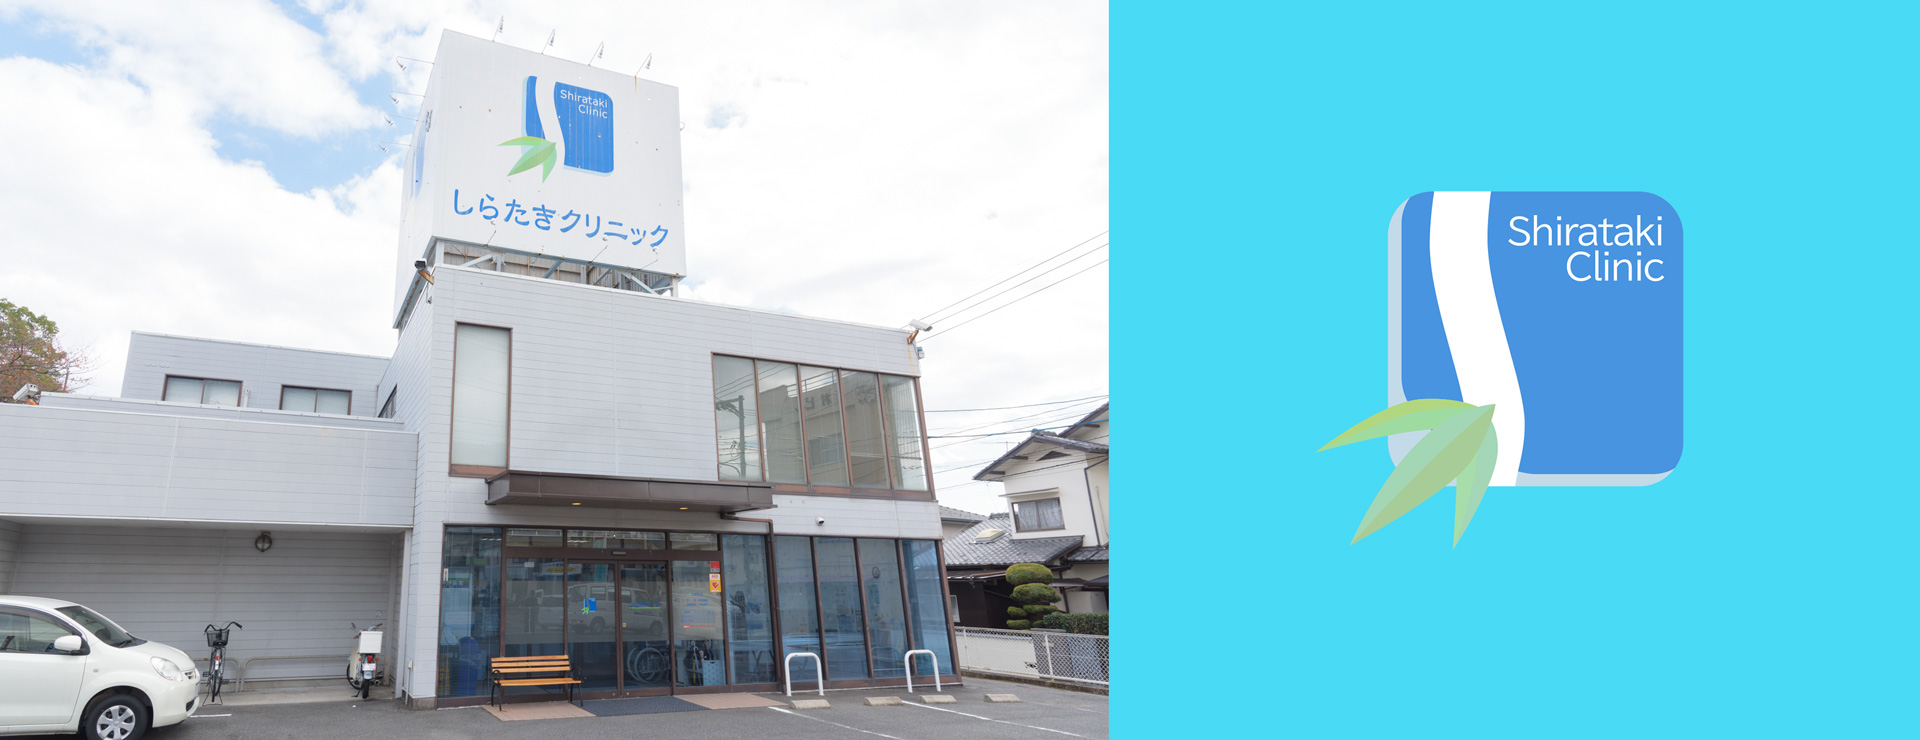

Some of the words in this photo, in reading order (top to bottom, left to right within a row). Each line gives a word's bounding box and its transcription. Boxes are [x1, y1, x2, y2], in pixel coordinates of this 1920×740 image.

[560, 89, 608, 108] Shirataki
[578, 104, 608, 119] Clinic
[453, 188, 669, 248] しらたきクリニック
